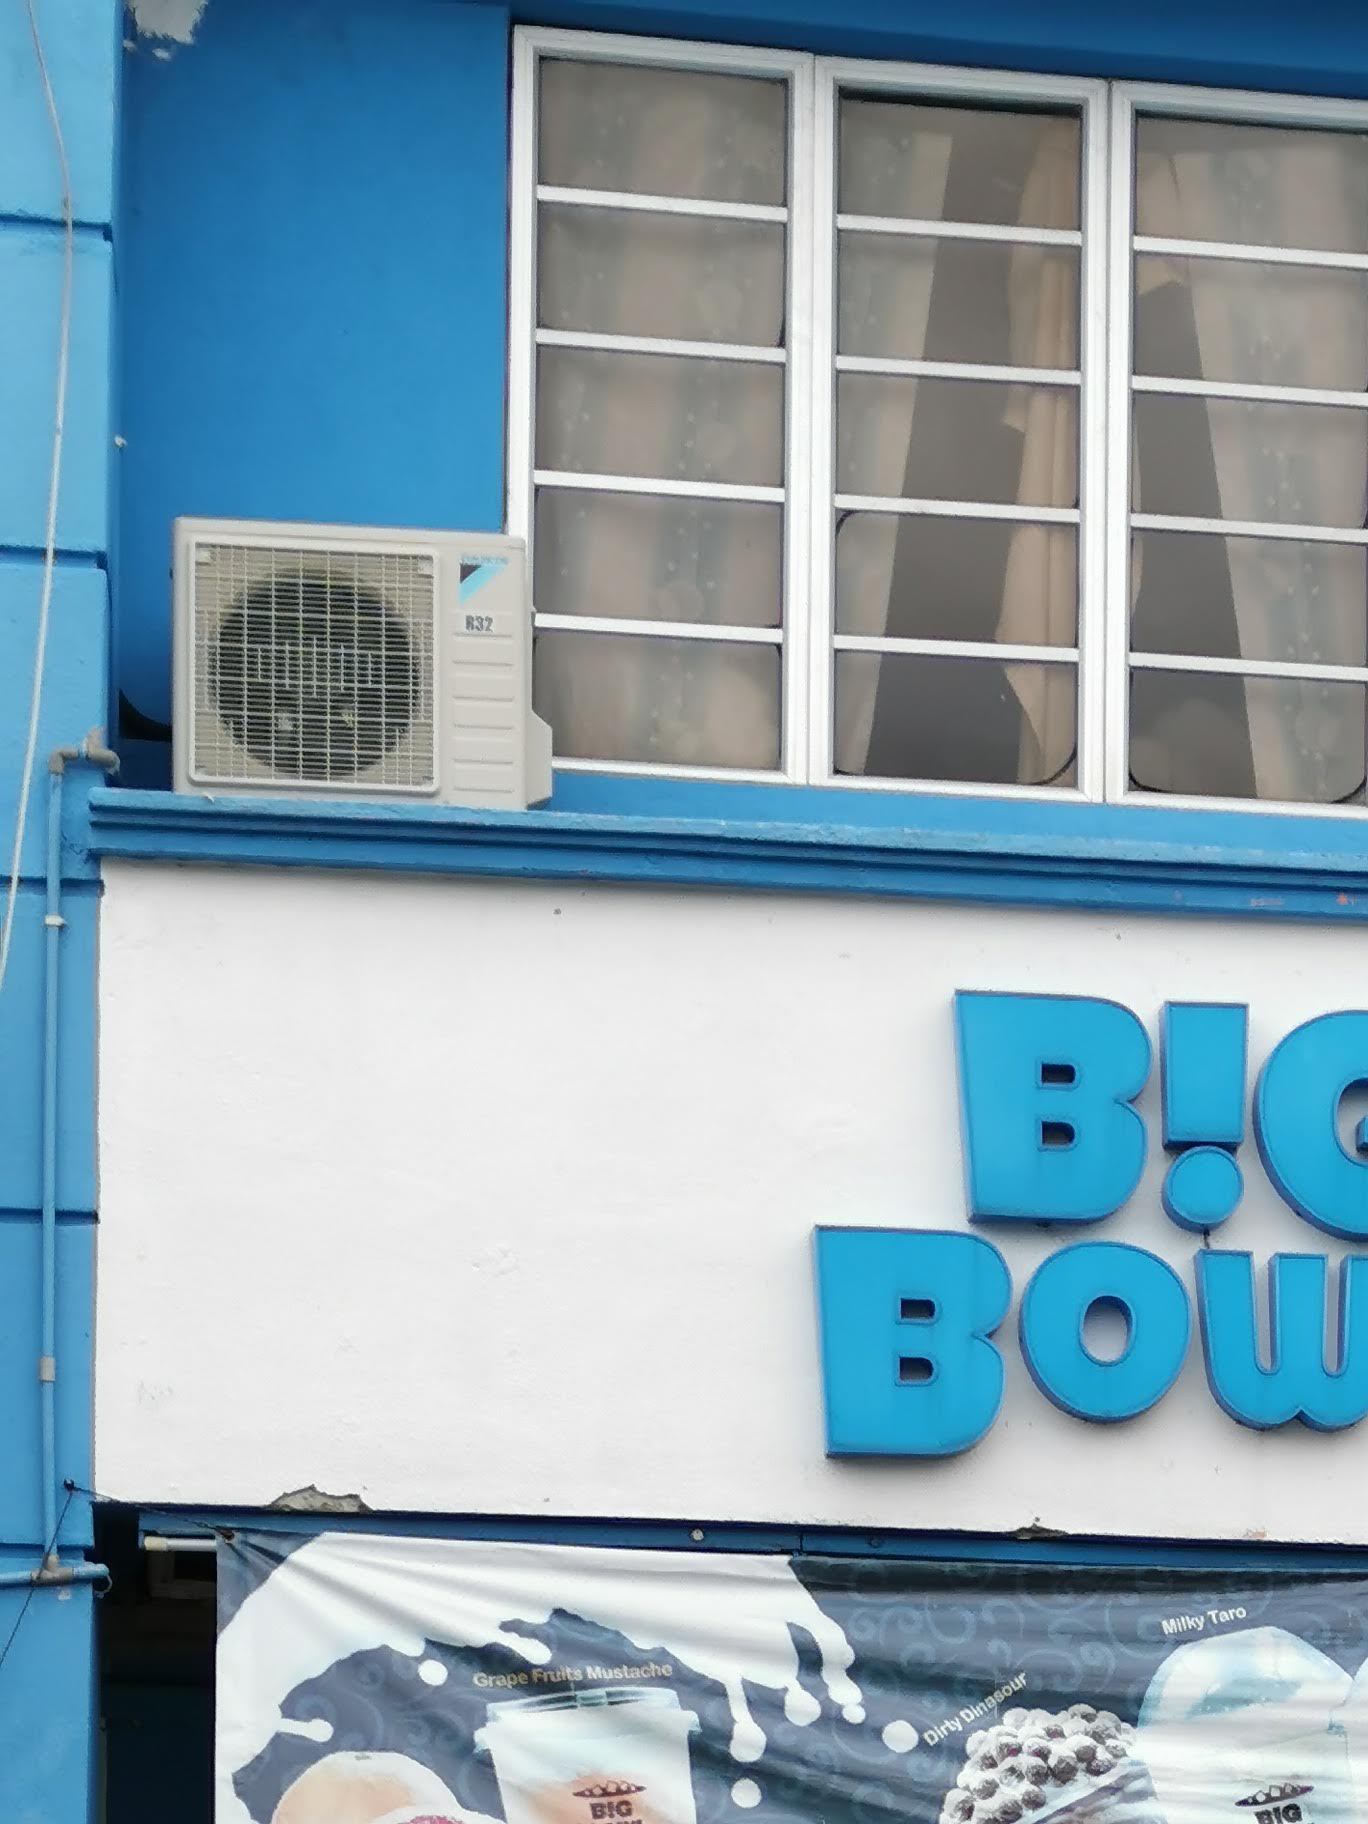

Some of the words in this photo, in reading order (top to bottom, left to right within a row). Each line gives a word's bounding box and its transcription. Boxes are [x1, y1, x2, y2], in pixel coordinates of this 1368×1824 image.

[465, 614, 494, 632] R32
[1161, 1615, 1205, 1636] Milky
[1207, 1606, 1247, 1625] Taro
[472, 1670, 529, 1689] Grape
[531, 1666, 583, 1684] Fruits
[586, 1661, 673, 1680] Mustache
[922, 1717, 964, 1747] Dirty
